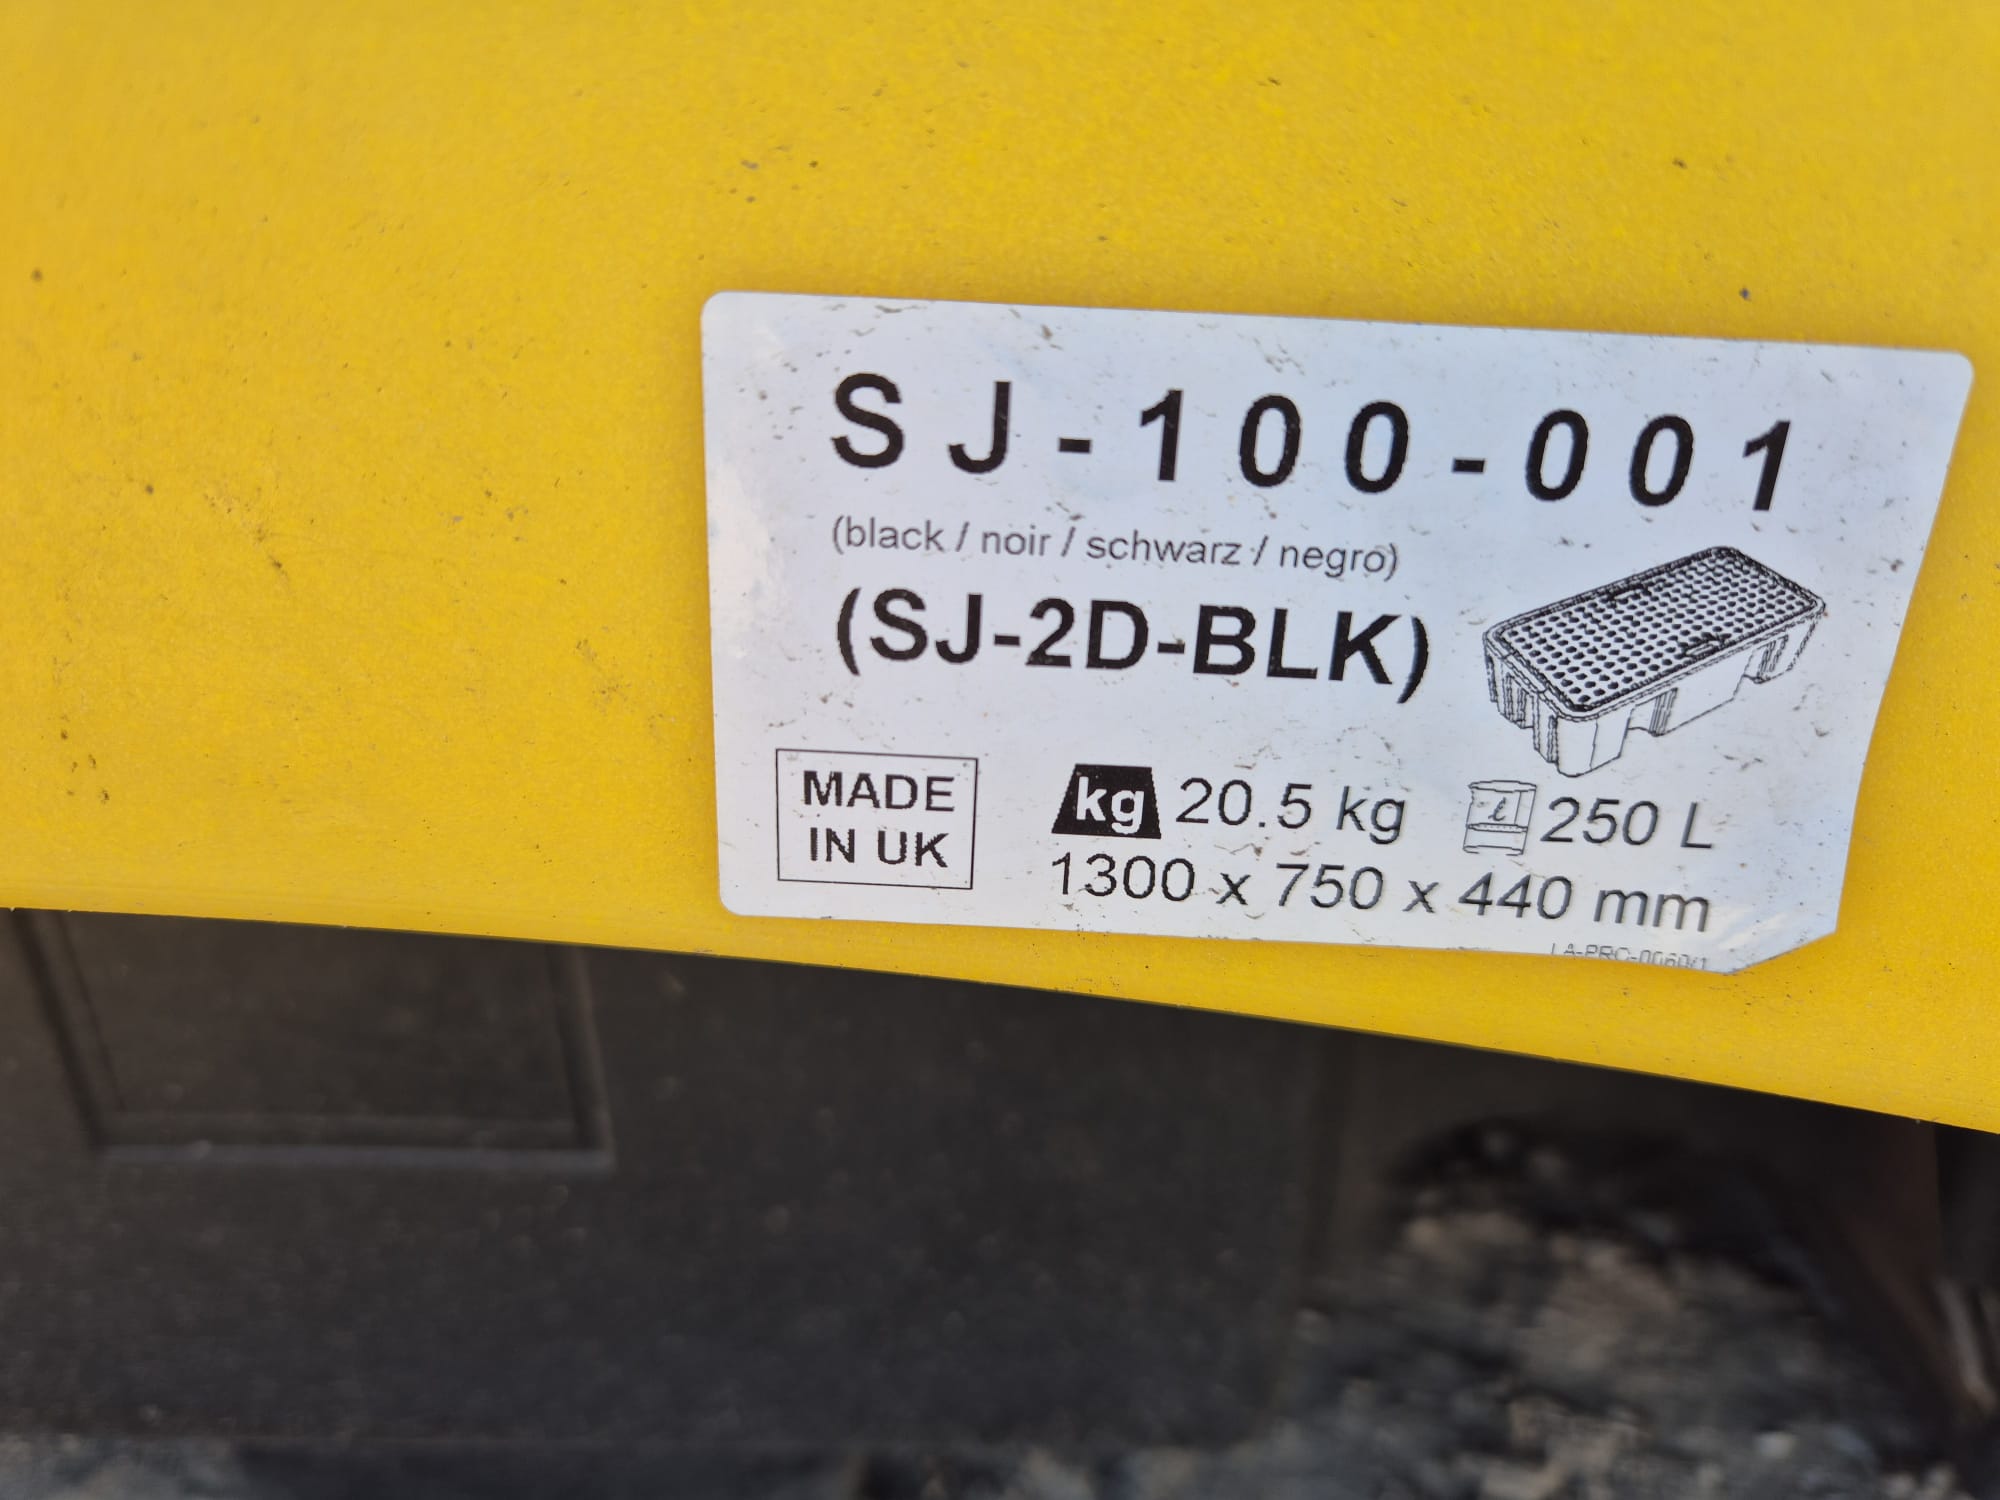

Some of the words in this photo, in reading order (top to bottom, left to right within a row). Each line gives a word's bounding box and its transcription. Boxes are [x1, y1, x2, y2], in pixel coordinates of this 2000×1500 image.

[831, 373, 1791, 512] SJ-100-001
[833, 516, 944, 555] (black
[957, 522, 969, 552] /
[982, 525, 1051, 556] noir
[1061, 526, 1076, 557] /
[1087, 529, 1242, 566] schwarz
[1253, 535, 1269, 566] /
[1280, 543, 1398, 582] negro)
[837, 588, 1429, 706] (SJ-2D-BLK)
[803, 771, 955, 812] MADE
[1076, 776, 1144, 834] kg
[1176, 777, 1313, 830] 20.5
[1337, 785, 1405, 844] kg
[1540, 796, 1659, 846] 250
[1680, 802, 1713, 849] L
[810, 827, 856, 864] IN
[877, 831, 949, 868] UK
[1052, 852, 1196, 902] 1300
[1216, 872, 1252, 906] x
[1277, 863, 1384, 910] 750
[1403, 880, 1439, 914] x
[1458, 872, 1573, 920] 440
[1593, 889, 1710, 932] mm
